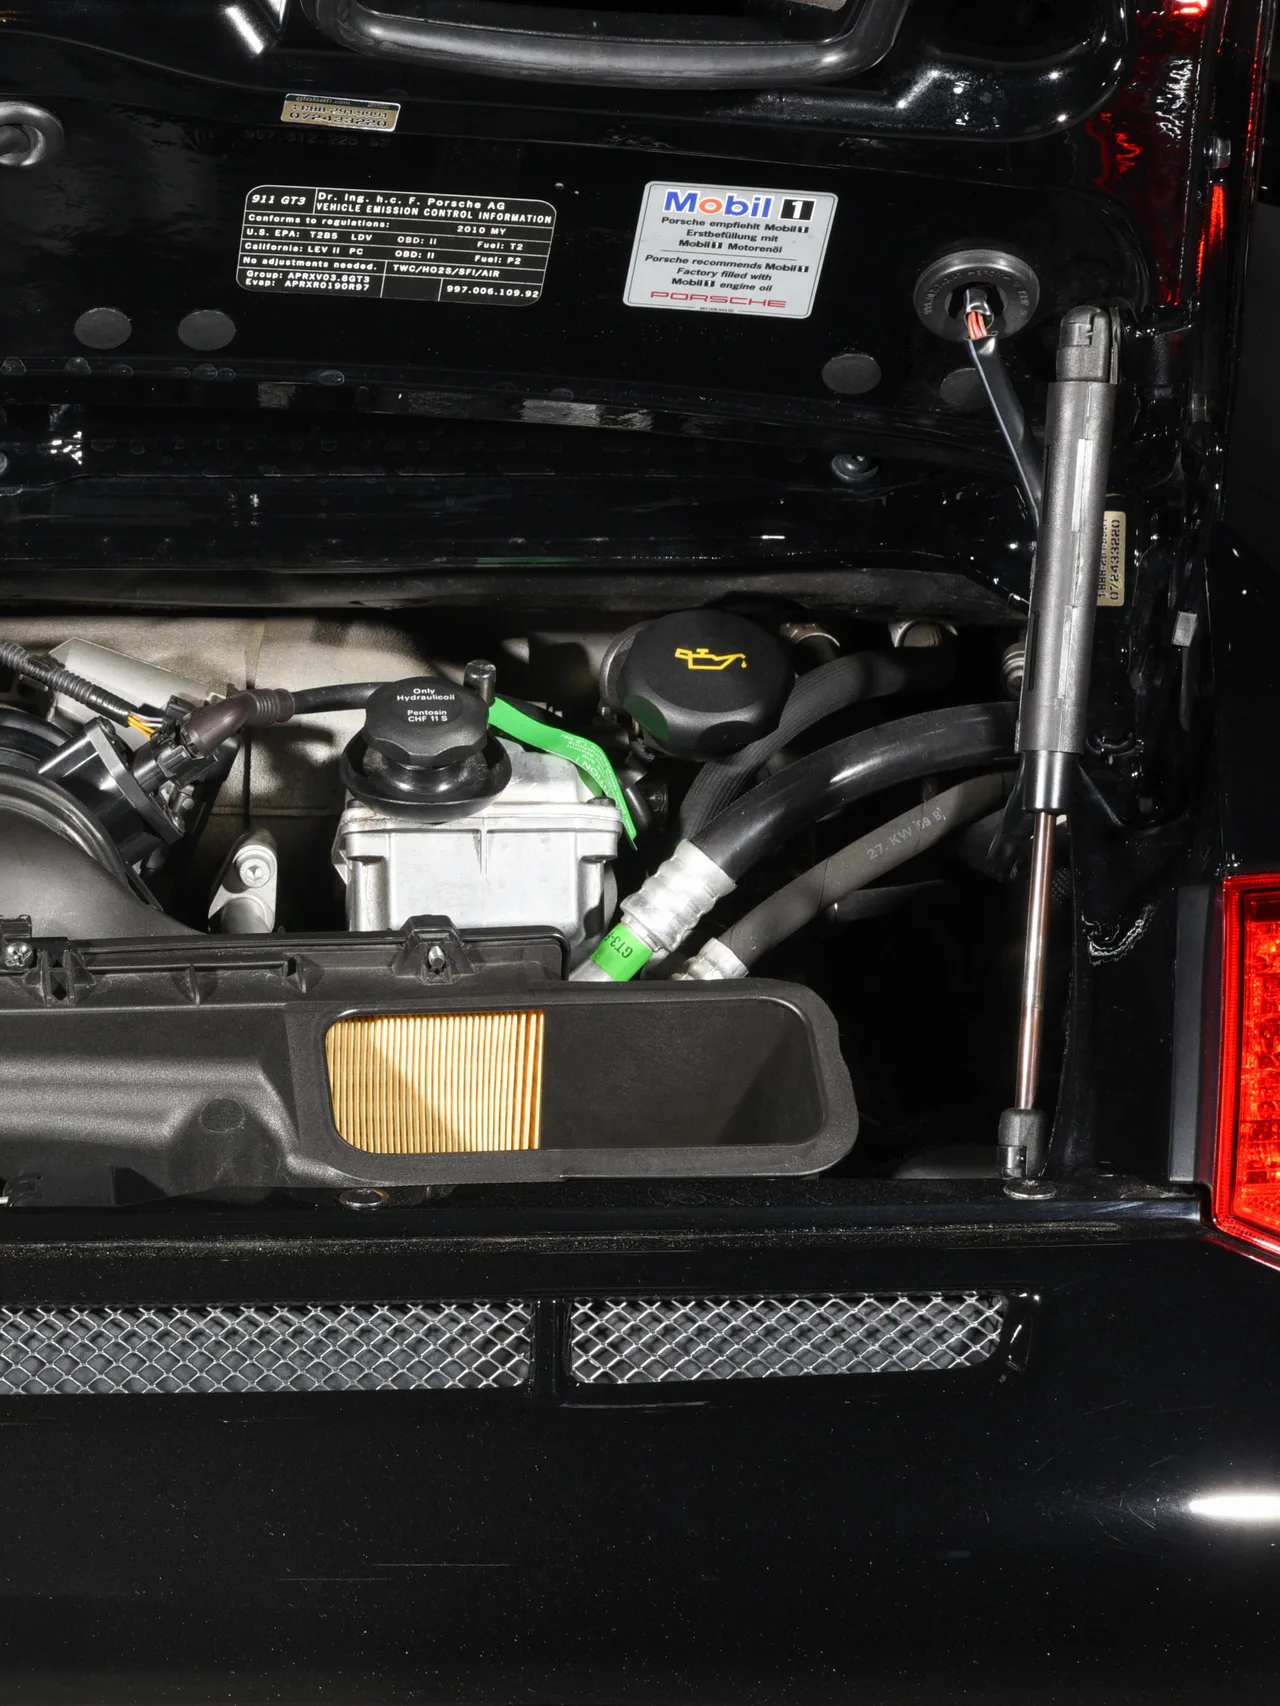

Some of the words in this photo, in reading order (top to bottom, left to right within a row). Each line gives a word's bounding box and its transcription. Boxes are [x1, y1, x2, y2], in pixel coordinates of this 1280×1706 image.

[251, 194, 278, 205] 911
[281, 195, 306, 206] GT3
[318, 192, 337, 201] Dr.
[344, 193, 370, 205] Ing.
[376, 195, 402, 205] h.c.
[409, 197, 421, 205] F.
[427, 197, 482, 210] Porsche
[487, 201, 506, 210] AG
[664, 190, 773, 218] Mobil
[316, 202, 361, 214] VEHICLE
[366, 204, 419, 216] EMISSION
[424, 208, 473, 219] CONTROL
[478, 210, 552, 224] INFORMATION
[248, 213, 301, 224] Conforms
[305, 216, 317, 225] to
[321, 217, 390, 229] regulations:
[661, 217, 706, 227] Porsche
[709, 219, 760, 230] empfiehlt
[457, 225, 486, 235] 2010
[490, 227, 507, 236] MY
[686, 229, 758, 242] Erstbefüllung
[760, 234, 779, 242] mit
[246, 228, 269, 237] U.S.
[275, 229, 300, 238] EPA:
[309, 231, 338, 240] T2B5
[351, 233, 373, 241] LDV
[397, 236, 424, 245] OBD:
[476, 240, 505, 250] Fuel:
[509, 242, 524, 251] T2
[244, 242, 303, 252] California:
[307, 245, 329, 254] LEV
[349, 246, 364, 255] PC
[395, 250, 422, 259] OBD:
[474, 254, 502, 263] Fuel:
[507, 256, 522, 265] P2
[727, 243, 782, 253] Motorenöl
[243, 256, 258, 265] No
[262, 257, 336, 270] adjustments
[340, 260, 377, 271] needed.
[644, 255, 689, 264] Porsche
[692, 258, 762, 270] recommends
[246, 270, 284, 281] Group:
[393, 264, 500, 278] TWC/HO2S/SFI/AIR
[676, 267, 718, 278] Factory
[721, 270, 748, 279] filled
[245, 278, 276, 288] Evap:
[719, 281, 756, 291] engine
[759, 284, 773, 292] oil
[447, 285, 539, 299] 997.006.109.92
[650, 291, 787, 308] PORSCHE
[1110, 519, 1120, 600] 072433220
[397, 694, 455, 702] Hydraulicoil
